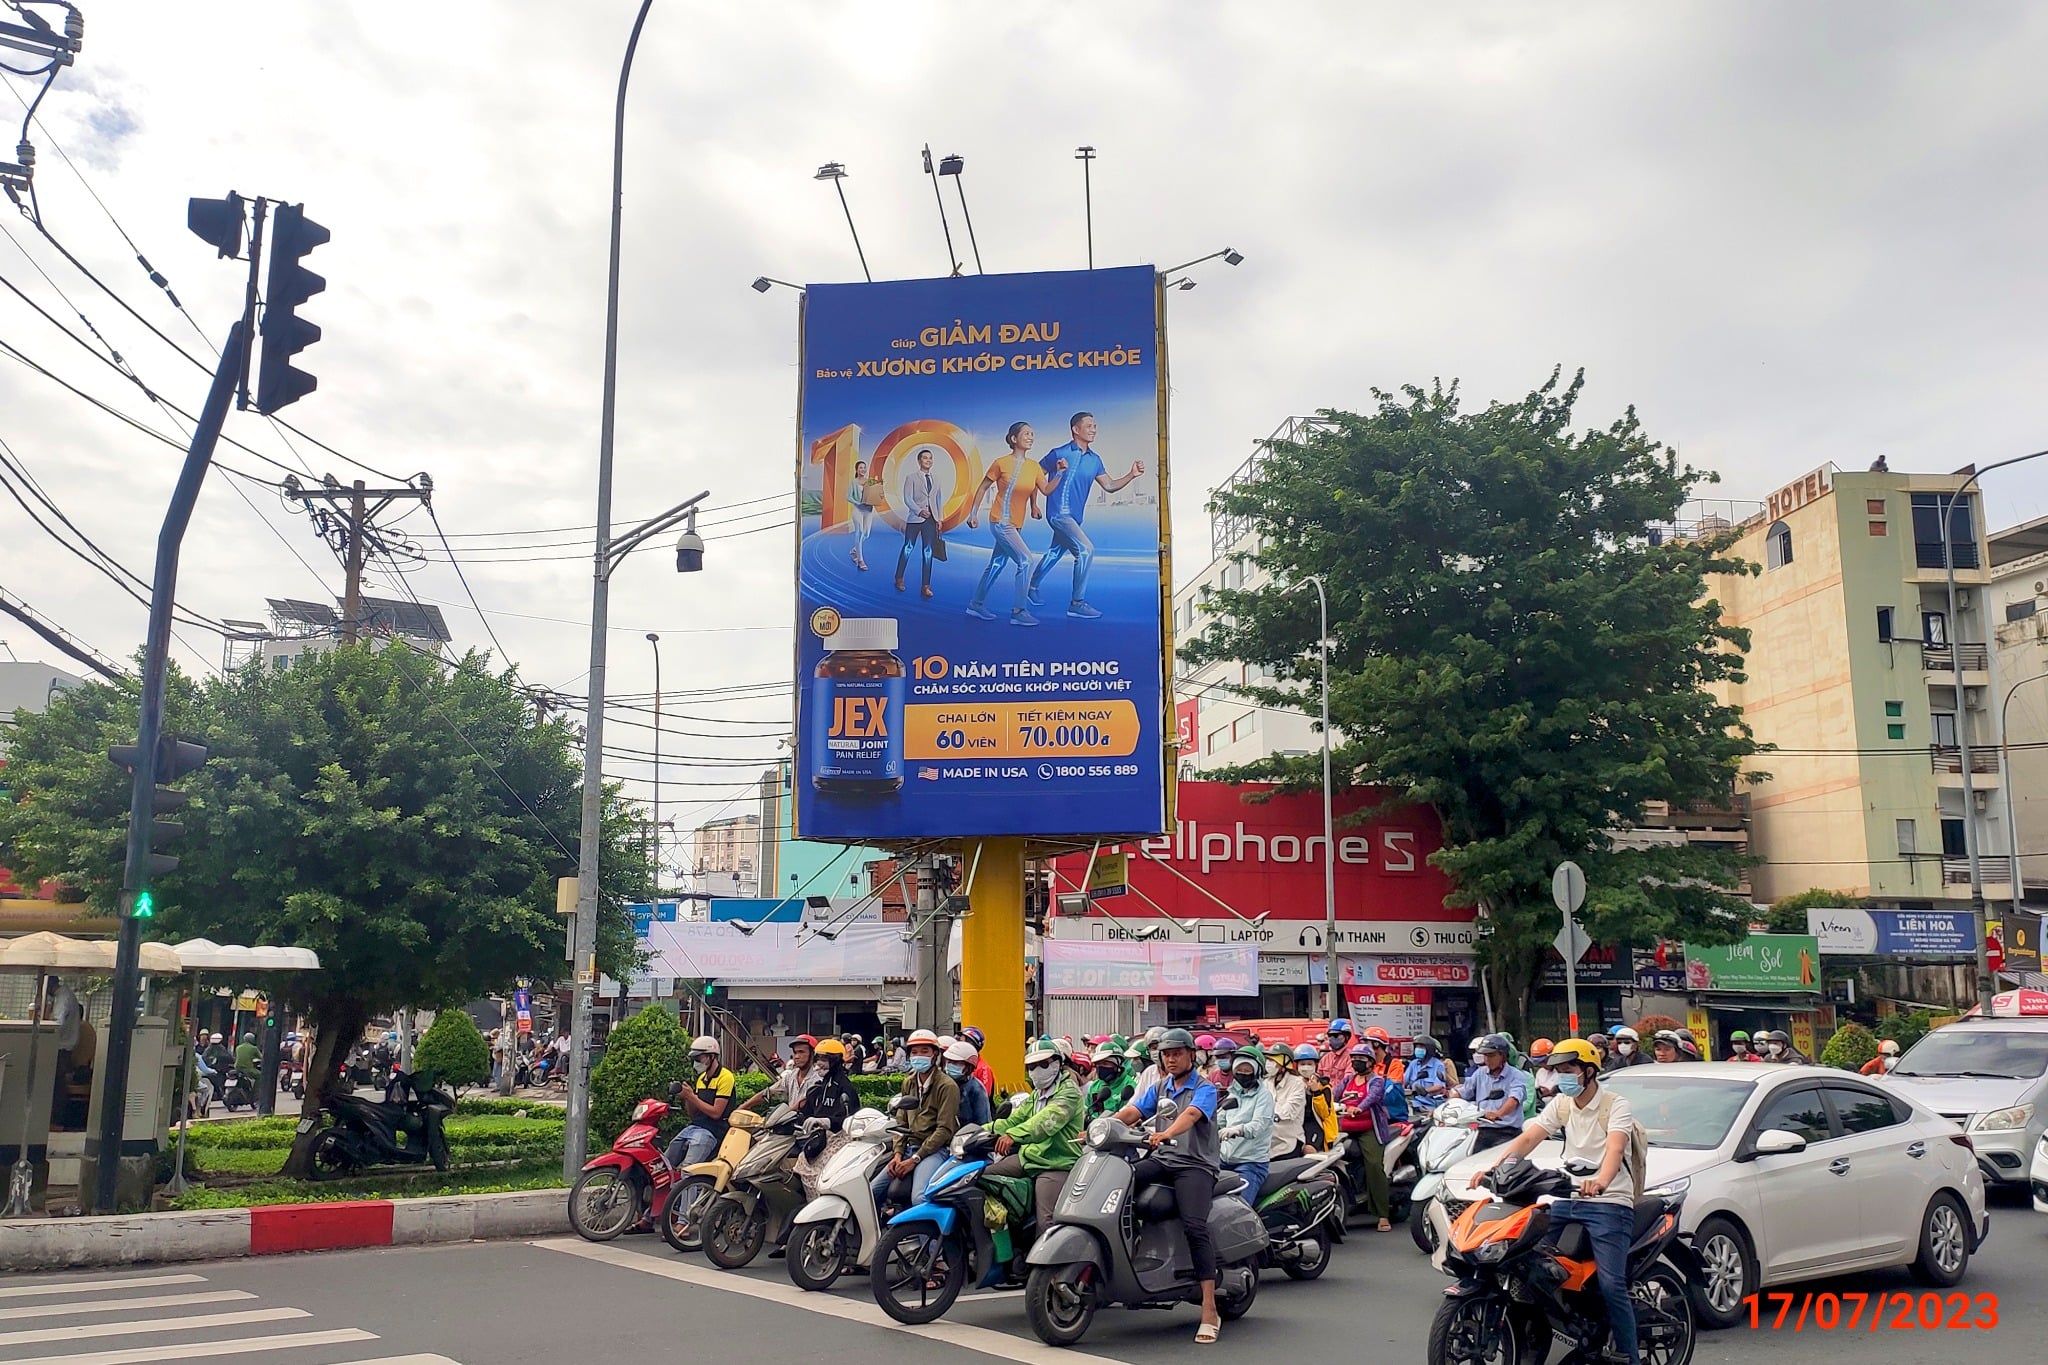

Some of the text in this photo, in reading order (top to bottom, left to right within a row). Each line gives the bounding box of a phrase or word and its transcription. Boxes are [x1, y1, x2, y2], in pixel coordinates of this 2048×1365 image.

[891, 319, 1060, 349] Giúp GIẢM ĐAU
[816, 344, 1142, 380] Bảo vệ XƯƠNG KHỚP CHẮC KHỎE
[1768, 469, 1829, 522] HOTEL
[912, 655, 1119, 680] 10 NĂM TIÊN PHONG
[913, 678, 1132, 694] CHĂM SÓC XƯƠNG KHỚP NGƯỜI VIỆT
[827, 697, 889, 737] JEX
[937, 711, 996, 723] CHAI LỚN
[1017, 709, 1112, 723] TIẾT KIỆM NGAY
[829, 740, 889, 749] NATURAL JOINT
[936, 729, 997, 749] 60 VIÊN
[836, 751, 882, 759] PAIN RELIEF
[885, 760, 897, 772] 60
[1055, 765, 1139, 777] 1800 556 889
[943, 767, 1029, 778] MADE IN USA
[1898, 919, 1955, 931] LIÊN HOA
[1231, 929, 1274, 942] LAPTOP
[1348, 931, 1386, 943] THANH
[1434, 931, 1473, 944] THU CŨ
[1760, 946, 1783, 973] Sol
[1279, 967, 1285, 976] 2
[1387, 966, 1415, 979] 4.09
[1359, 994, 1376, 1003] GIÁ
[1377, 992, 1401, 1003] SIÊU
[1692, 1013, 1702, 1024] IN
[1689, 1028, 1707, 1039] PHO
[1794, 1026, 1811, 1038] PHO
[1797, 1040, 1809, 1050] TO
